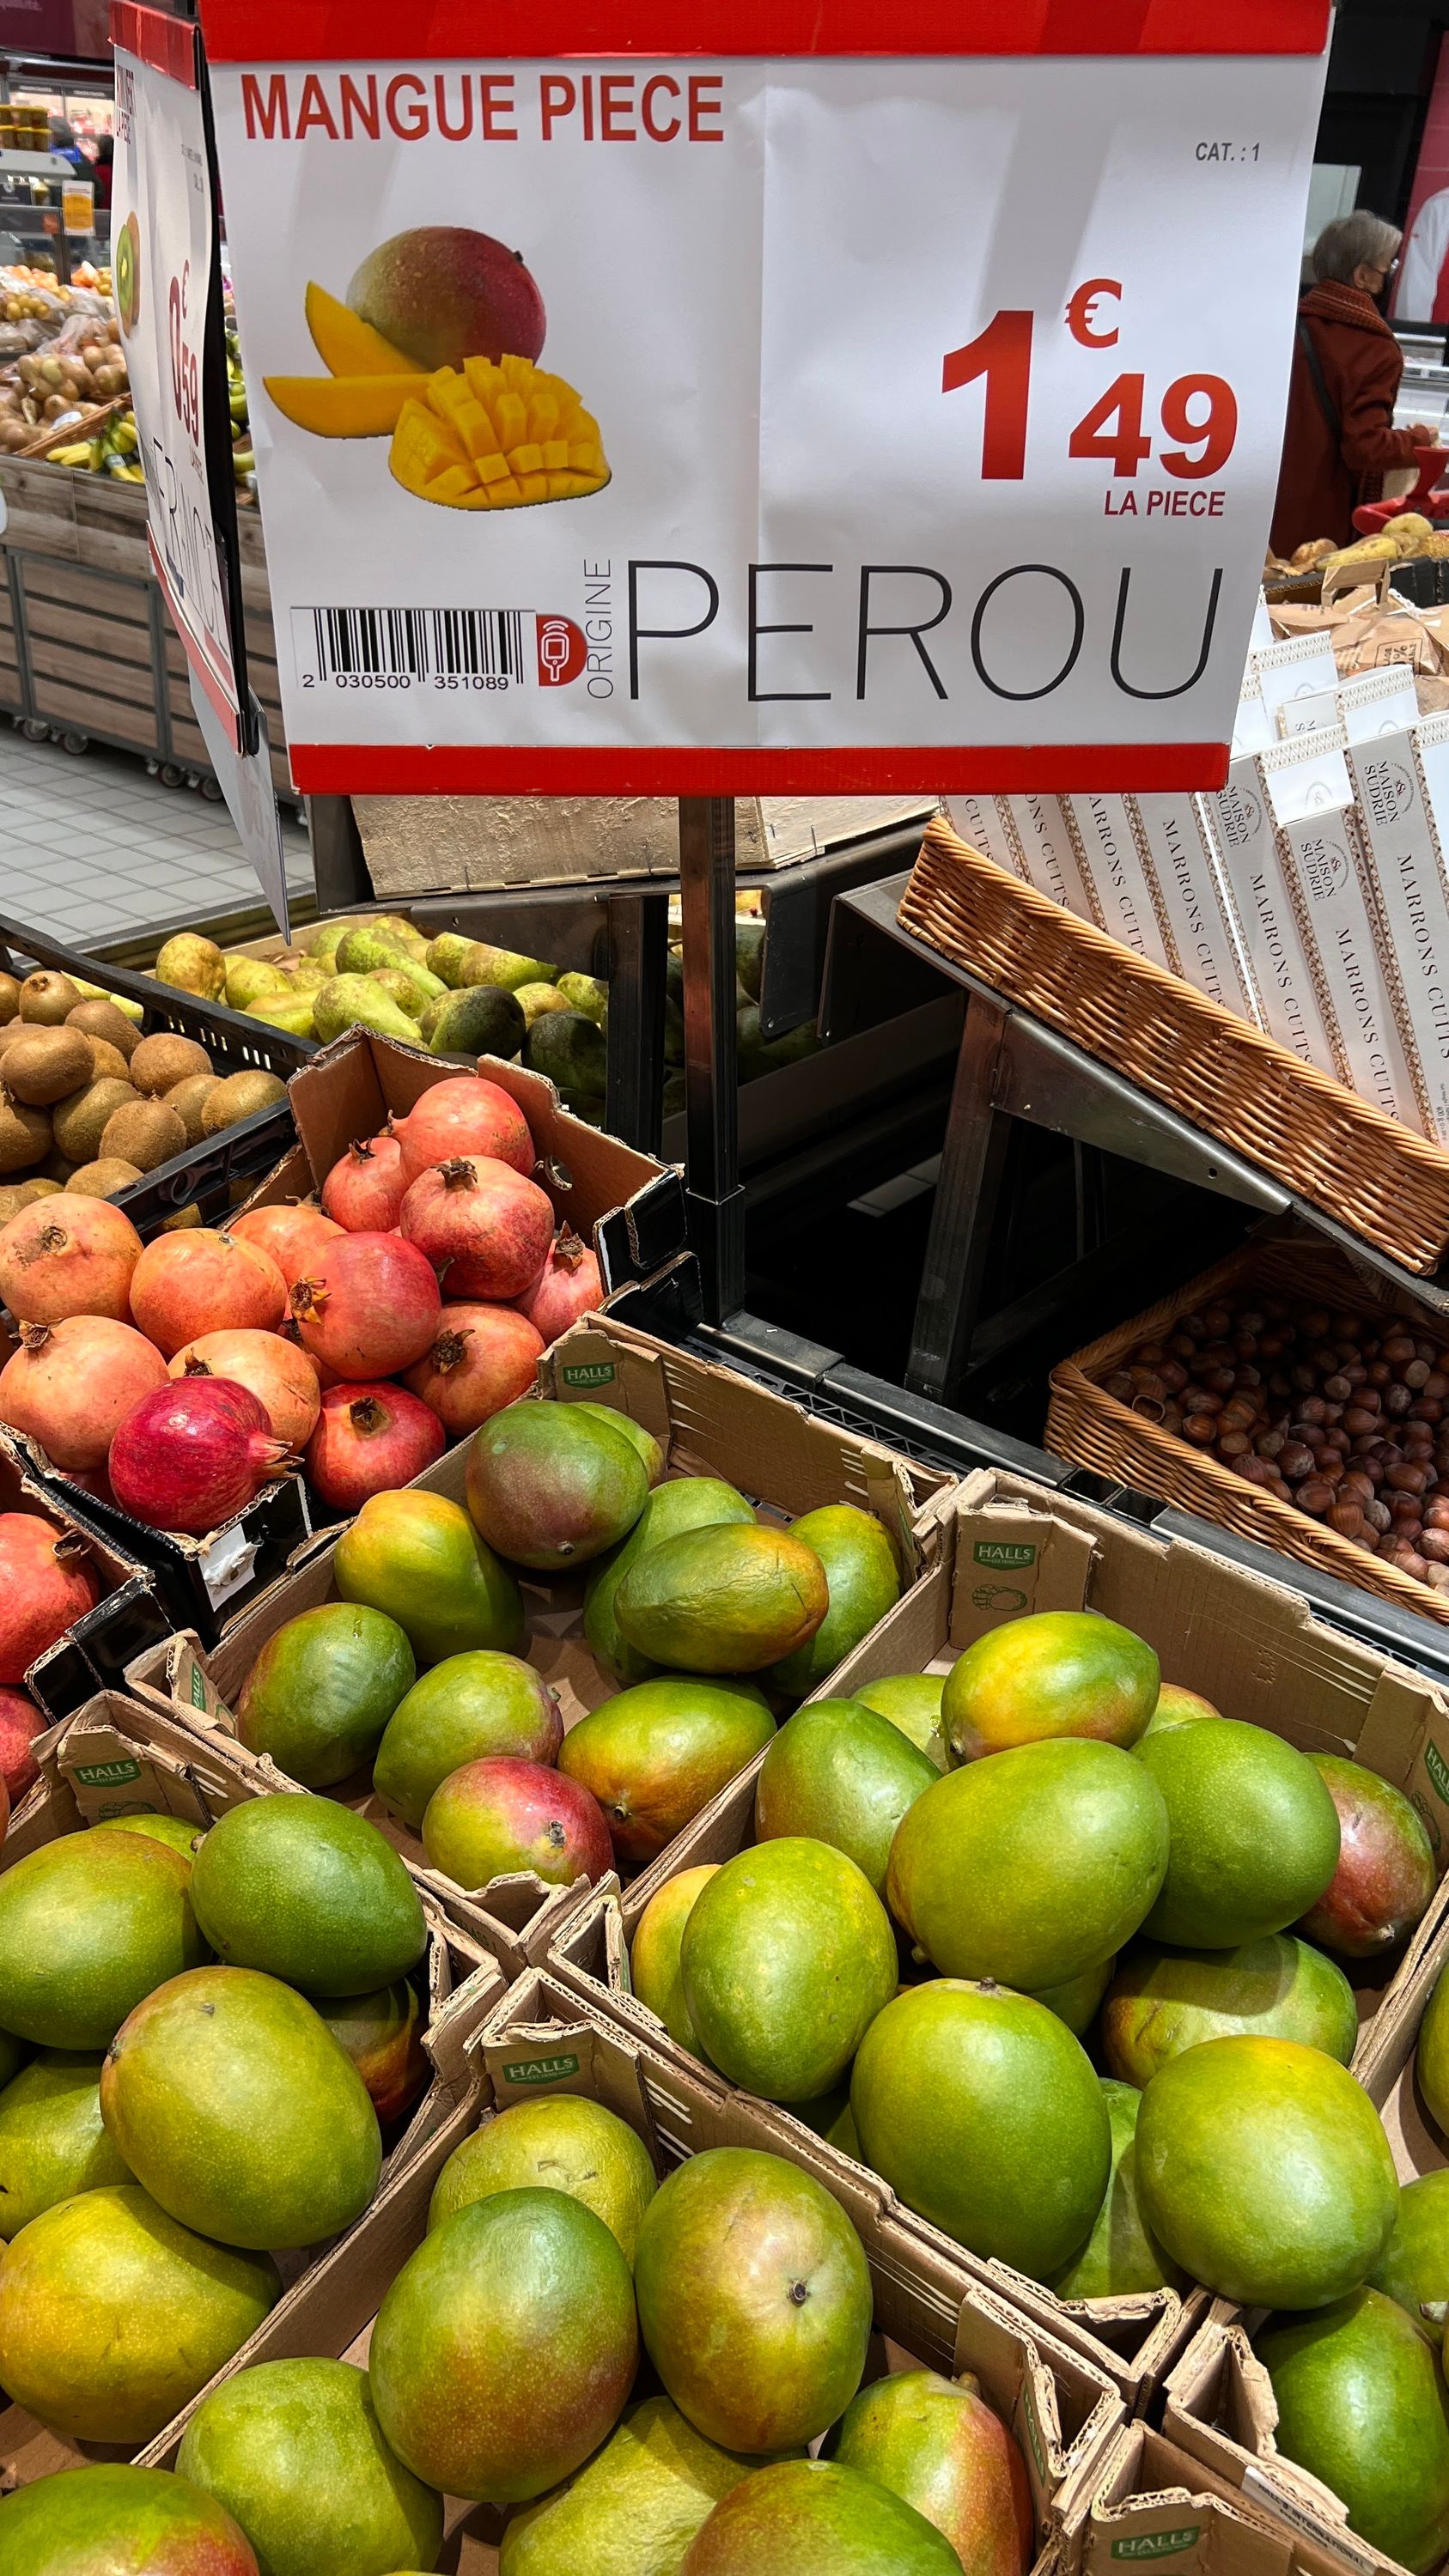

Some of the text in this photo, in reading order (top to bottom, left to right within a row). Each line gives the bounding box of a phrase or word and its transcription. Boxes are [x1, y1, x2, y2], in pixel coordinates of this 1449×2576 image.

[240, 73, 725, 142] MANGUE PIECE
[1195, 143, 1234, 161] CAT.
[1252, 143, 1260, 161] 1
[941, 278, 1239, 480] 1 € 49
[1104, 490, 1226, 516] LA PIECE
[584, 558, 614, 699] ORIGINE
[628, 560, 1223, 702] PEROU
[302, 675, 509, 690] 2 030500 351089
[1216, 792, 1240, 848] SUDRIE
[1227, 786, 1251, 844] MAISON
[1364, 765, 1388, 826] SUDRIE
[1376, 761, 1400, 822] MAISON
[1088, 796, 1126, 887] ARRONS
[1313, 838, 1337, 898] MAISON
[1162, 818, 1204, 934] MARRONS
[1300, 842, 1325, 902] SUDRIE
[1250, 873, 1293, 988] MARRONS
[1397, 854, 1438, 976] MARRONS
[1335, 927, 1379, 1044] MARRONS
[567, 1365, 612, 1380] HALLS
[978, 1546, 1031, 1559] HALLS
[79, 1762, 136, 1779] HALLS
[508, 2057, 574, 2078] HALLS
[1118, 2530, 1192, 2554] HALLS
